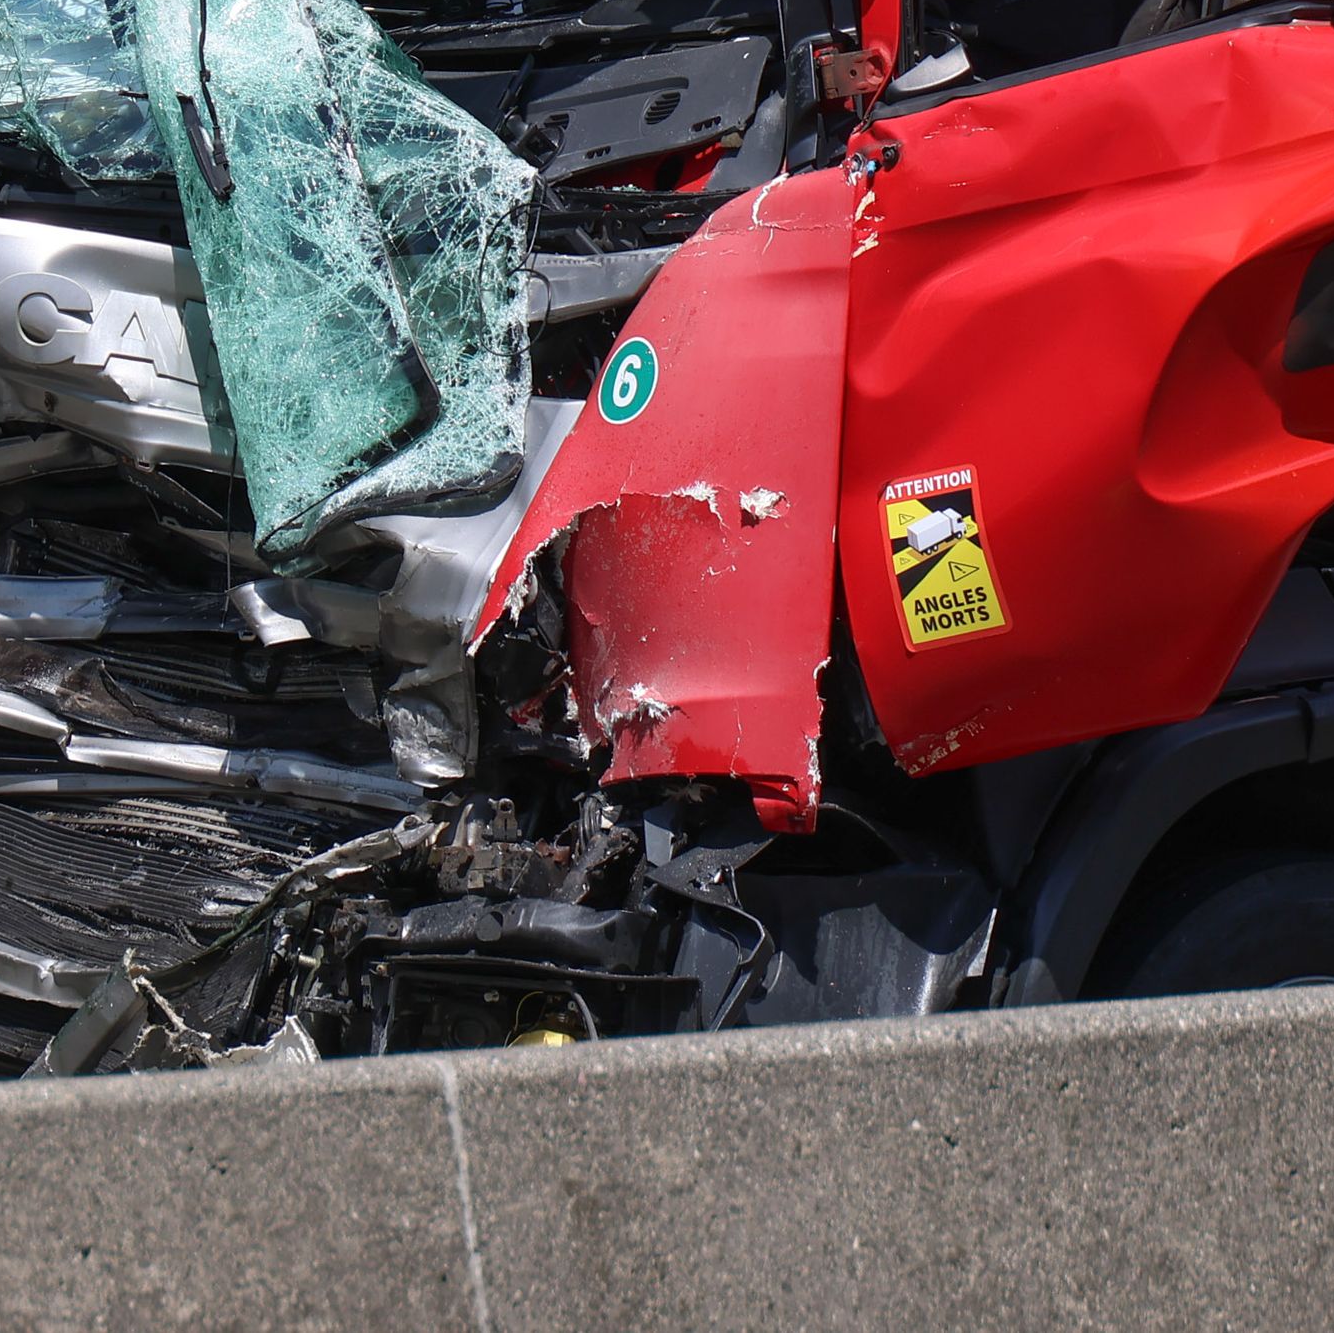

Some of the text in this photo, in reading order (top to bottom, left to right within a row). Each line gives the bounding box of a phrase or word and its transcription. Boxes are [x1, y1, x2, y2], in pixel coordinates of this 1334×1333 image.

[612, 354, 642, 407] 6
[885, 469, 972, 500] ATTENTION
[914, 586, 988, 616] ANGLES
[921, 605, 990, 633] MORTS
